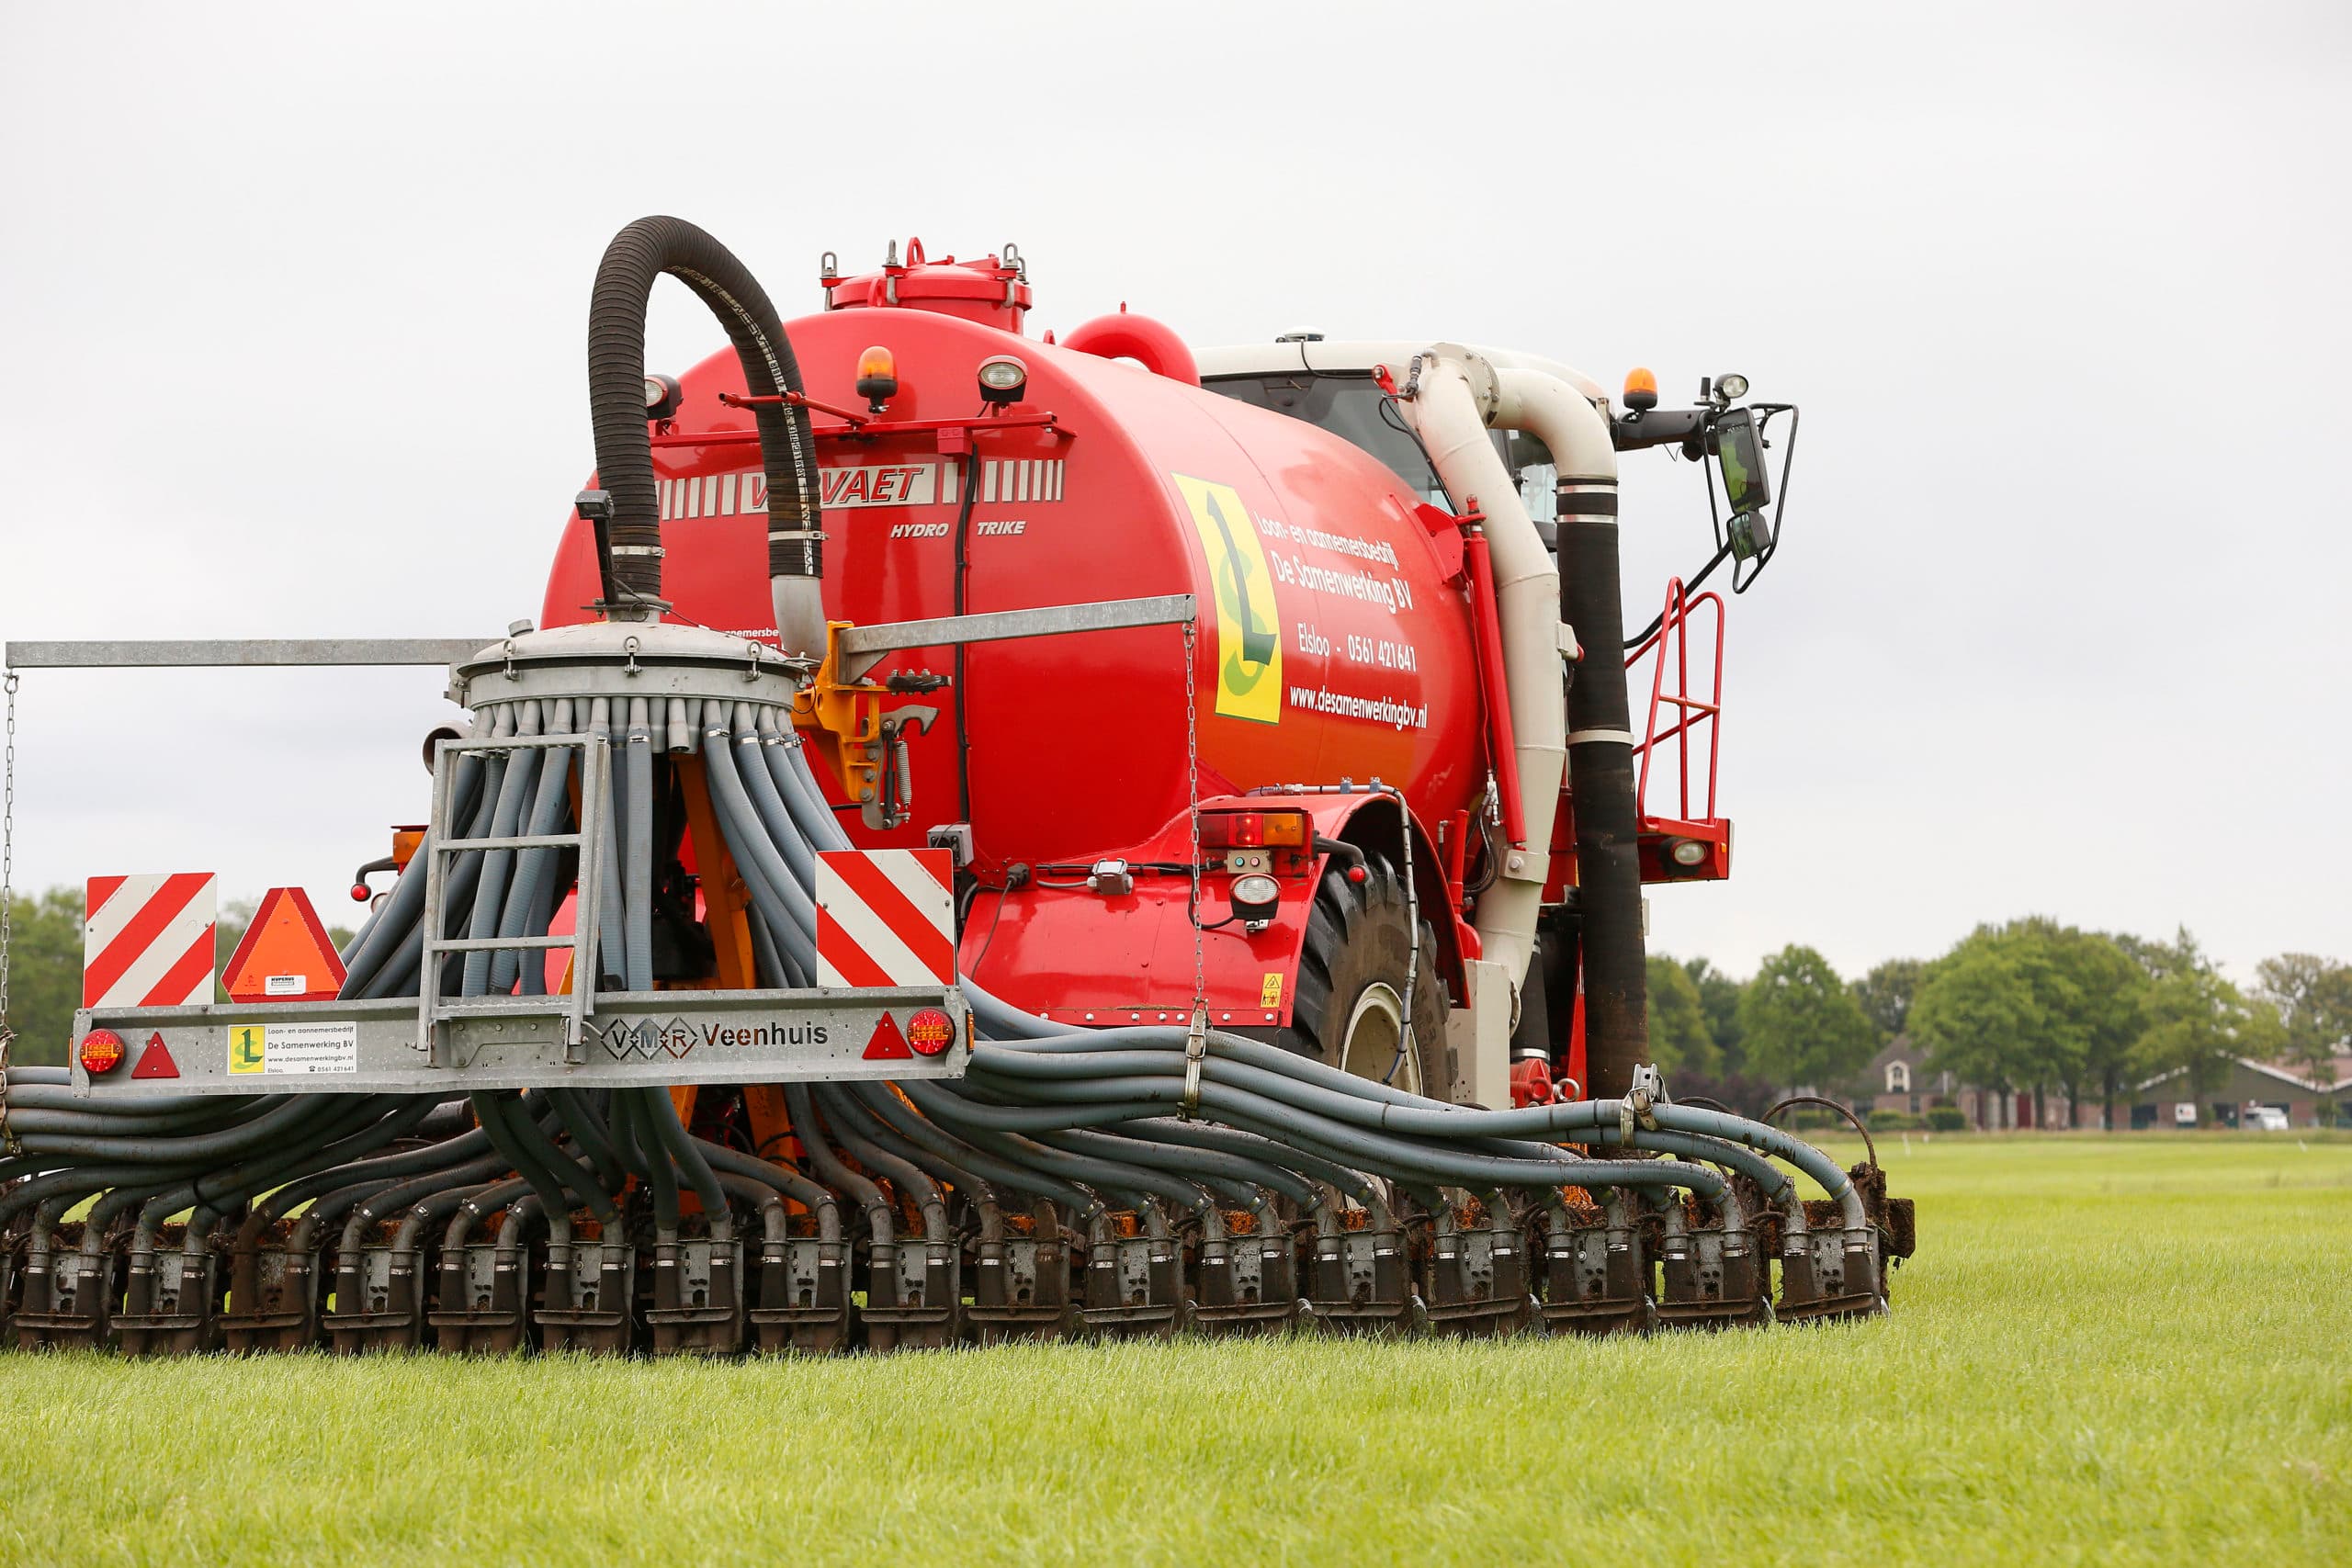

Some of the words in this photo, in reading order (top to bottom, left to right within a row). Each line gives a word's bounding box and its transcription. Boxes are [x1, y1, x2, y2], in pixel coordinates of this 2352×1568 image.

[752, 467, 924, 509] VVAET
[890, 523, 950, 538] HYDRO
[977, 521, 1026, 536] TRIKE
[1289, 525, 1308, 545] en
[1270, 549, 1295, 584] De
[1293, 555, 1396, 615] Samenwerking
[1391, 578, 1414, 610] BV
[1297, 622, 1330, 657] Elsloo
[1348, 634, 1374, 664] 0561
[1290, 685, 1428, 731] www.desamenwerkingbv.nl
[298, 1026, 354, 1034] aannemersbedrijf
[701, 1021, 829, 1047] Veenhuis
[281, 1040, 341, 1050] Samenwerking
[267, 1055, 354, 1064] www.desamenwerkingbv.nl
